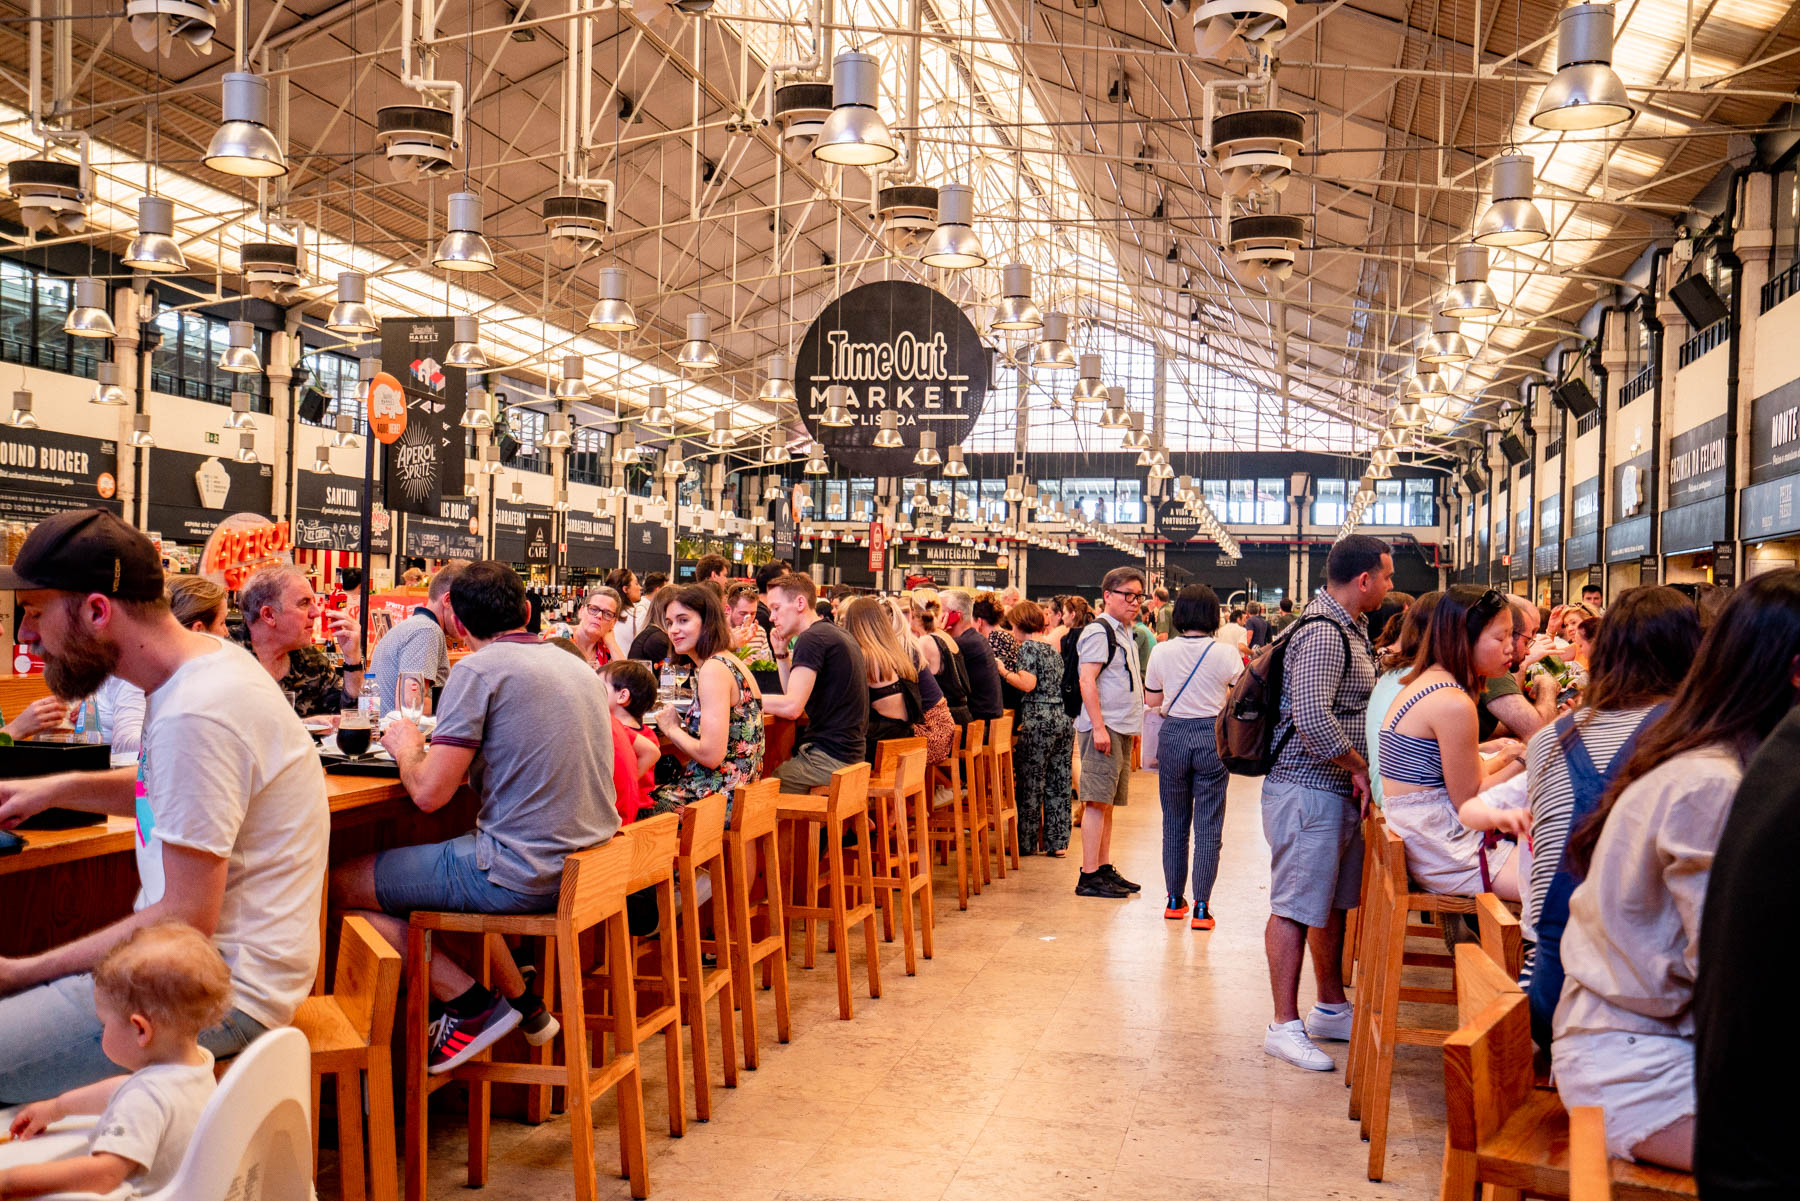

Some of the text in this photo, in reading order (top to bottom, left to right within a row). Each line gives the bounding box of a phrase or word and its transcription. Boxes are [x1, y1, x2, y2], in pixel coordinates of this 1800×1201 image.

[827, 330, 948, 381] Time Out
[810, 386, 969, 408] MARKET
[860, 415, 916, 426] LISOA
[1771, 406, 1798, 449] MONTE
[41, 446, 89, 475] BURGER
[397, 443, 436, 469] APEROL
[326, 486, 357, 507] SANTINI
[450, 503, 470, 520] BOLOS
[496, 509, 526, 527] GARRAFEIRA
[1162, 516, 1198, 525] PORTUGUESA
[1169, 507, 1175, 516] A
[593, 521, 614, 537] NACIONAL
[206, 521, 294, 574] APEROL
[926, 547, 980, 560] MANTEIGARIA
